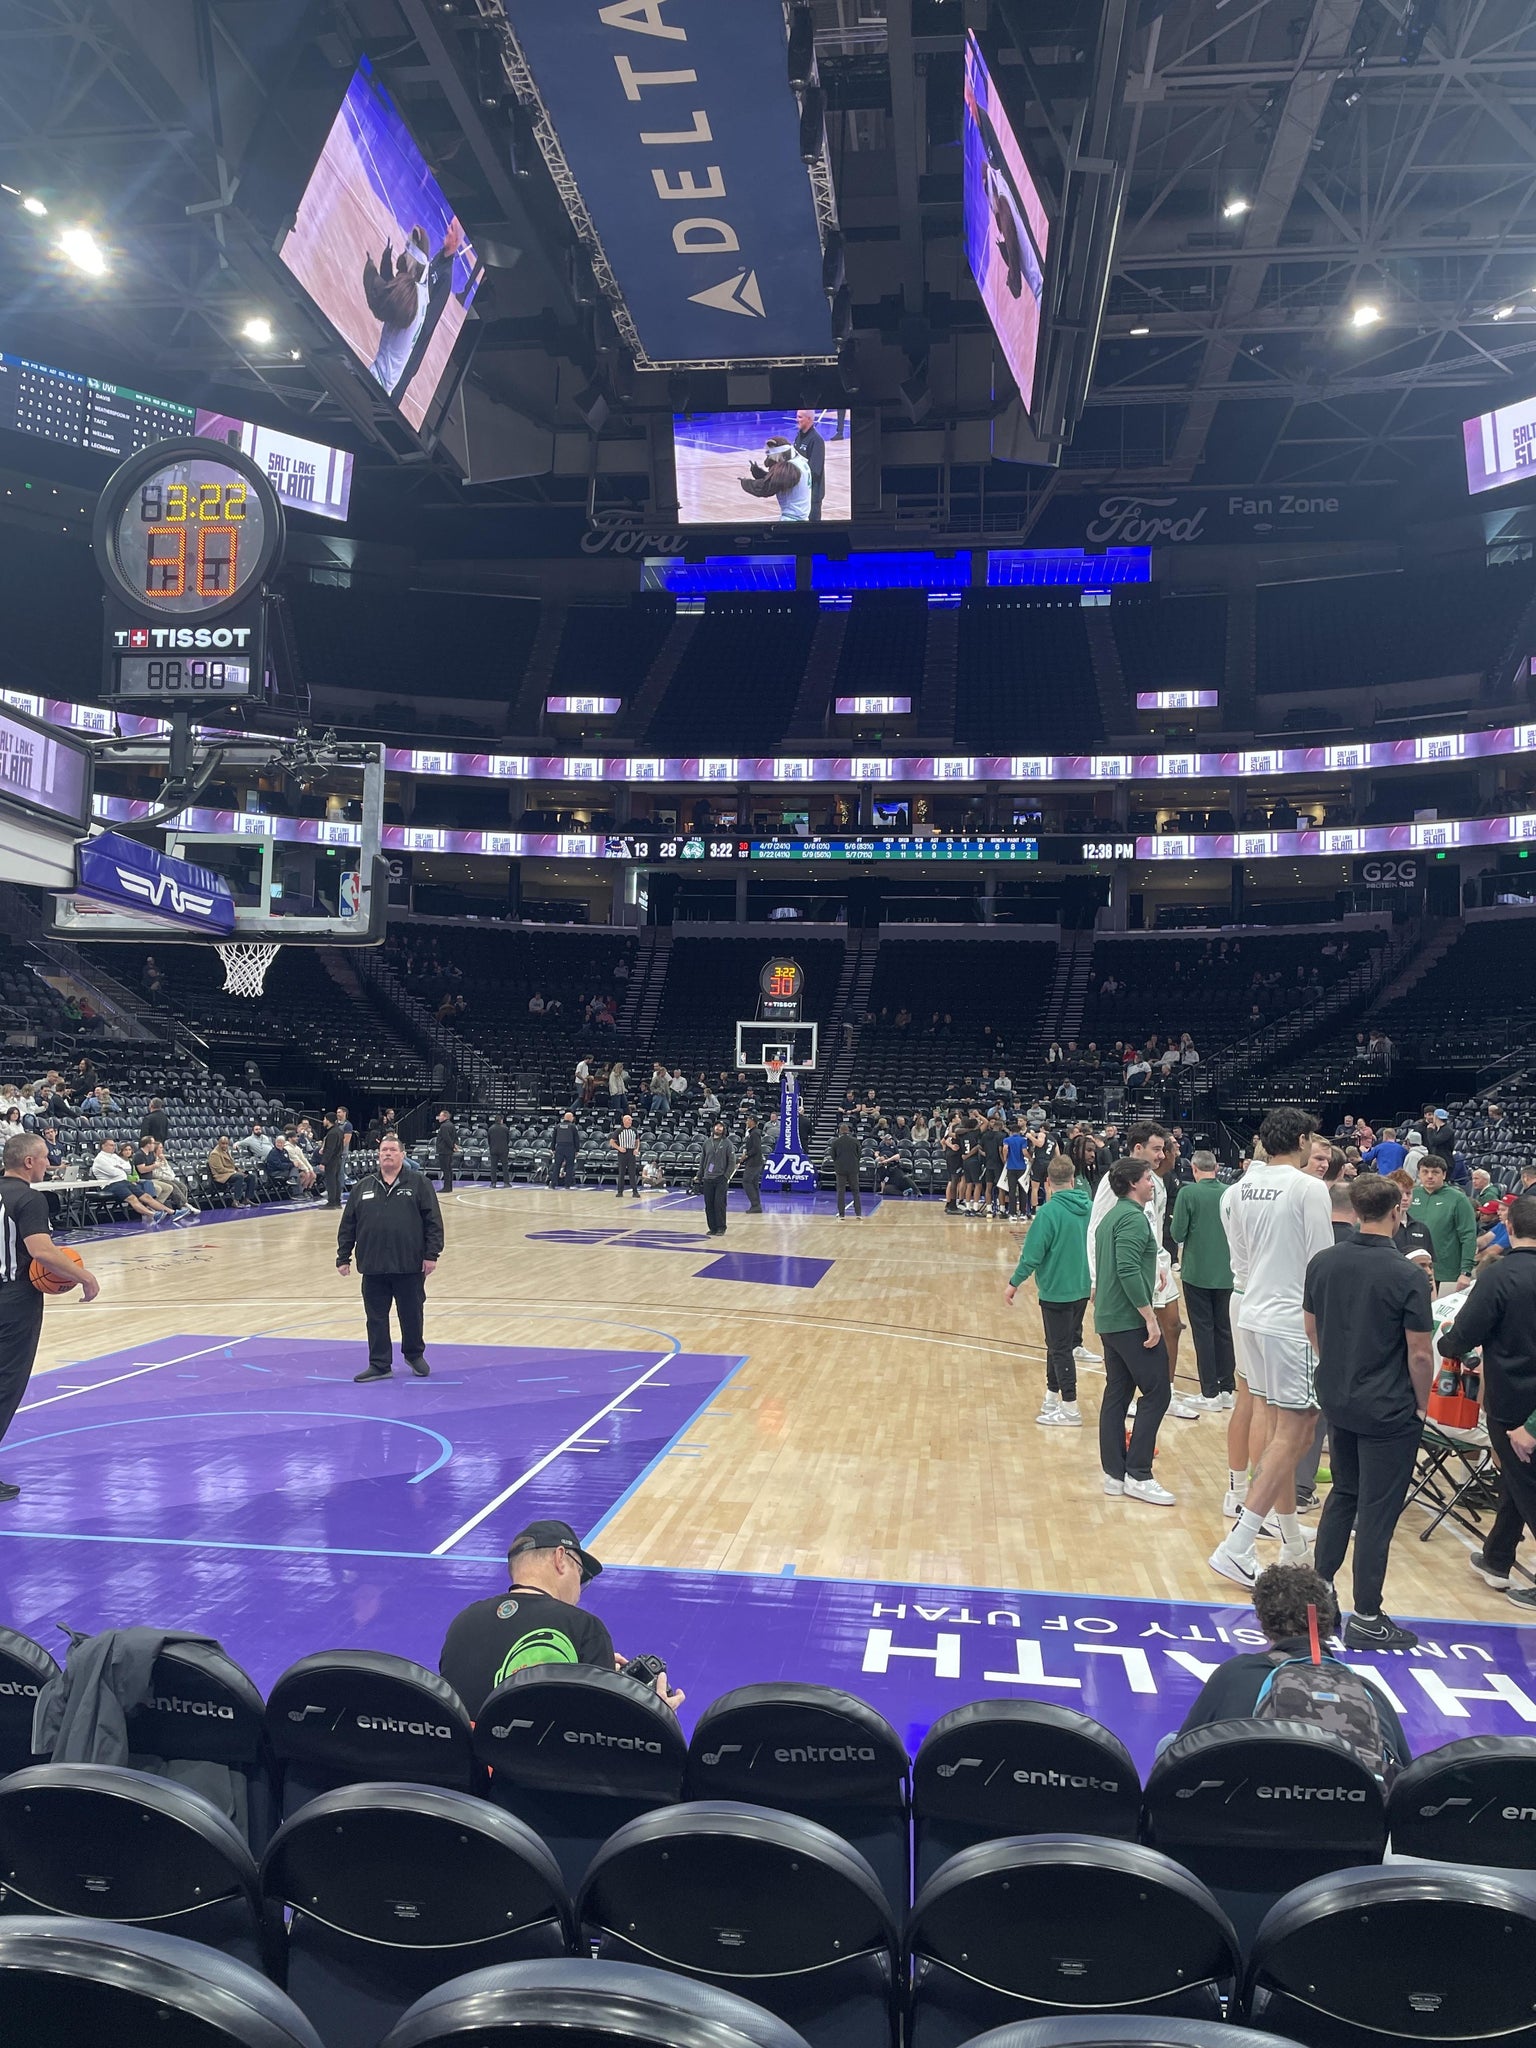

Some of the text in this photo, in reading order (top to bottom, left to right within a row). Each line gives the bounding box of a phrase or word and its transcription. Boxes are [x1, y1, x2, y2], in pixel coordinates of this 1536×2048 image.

[598, 0, 740, 254] DELTA
[103, 383, 116, 393] UVU
[268, 452, 316, 475] SALT LAKE
[268, 472, 315, 500] SLAM
[166, 484, 246, 521] 3:22
[1229, 496, 1338, 514] Fan Zone
[1086, 496, 1208, 542] Ford
[146, 526, 238, 596] 30
[152, 628, 250, 648] TISSOT
[1169, 698, 1187, 707] SLAM
[576, 704, 593, 712] SLAM
[865, 704, 882, 712] SLAM
[84, 718, 104, 730] SLAM
[0, 730, 34, 756] ALT LAKE
[1429, 747, 1450, 758] SLAM
[422, 762, 440, 770] SLAM
[1337, 756, 1357, 766] SLAM
[500, 766, 517, 775] SLAM
[1101, 767, 1120, 775] SLAM
[1169, 765, 1188, 774] SLAM
[1251, 762, 1270, 771] SLAM
[574, 768, 591, 776] SLAM
[710, 769, 726, 777] SLAM
[784, 769, 802, 777] SLAM
[862, 769, 880, 777] SLAM
[945, 768, 962, 776] SLAM
[1023, 768, 1040, 776] SLAM
[245, 825, 264, 834] SLAM
[330, 833, 349, 842] SLAM
[1424, 834, 1445, 843] SLAM
[415, 839, 433, 848] SLAM
[492, 843, 510, 852] SLAM
[1332, 840, 1352, 850] SLAM
[568, 845, 585, 853] SLAM
[634, 843, 648, 856] 13
[660, 843, 676, 857] 28
[710, 843, 733, 857] 3:22
[1083, 844, 1133, 859] 12:38 PM
[1246, 845, 1265, 854] SLAM
[1362, 860, 1416, 882] G2G
[342, 907, 352, 916] NBA
[775, 968, 795, 977] 3:22
[770, 977, 793, 995] 30
[965, 1143, 970, 1154] 3
[1046, 1144, 1053, 1154] 2
[1241, 1189, 1283, 1200] VALLEY
[1440, 1379, 1453, 1393] G
[872, 1602, 1494, 1662] UNESITY OF UTAH
[862, 1628, 1536, 1722] HLTH
[356, 1712, 452, 1740] entrata
[563, 1728, 662, 1754] entrata
[774, 1745, 876, 1762] entrata
[1012, 1767, 1118, 1793] entrata
[1256, 1785, 1366, 1802] entrata
